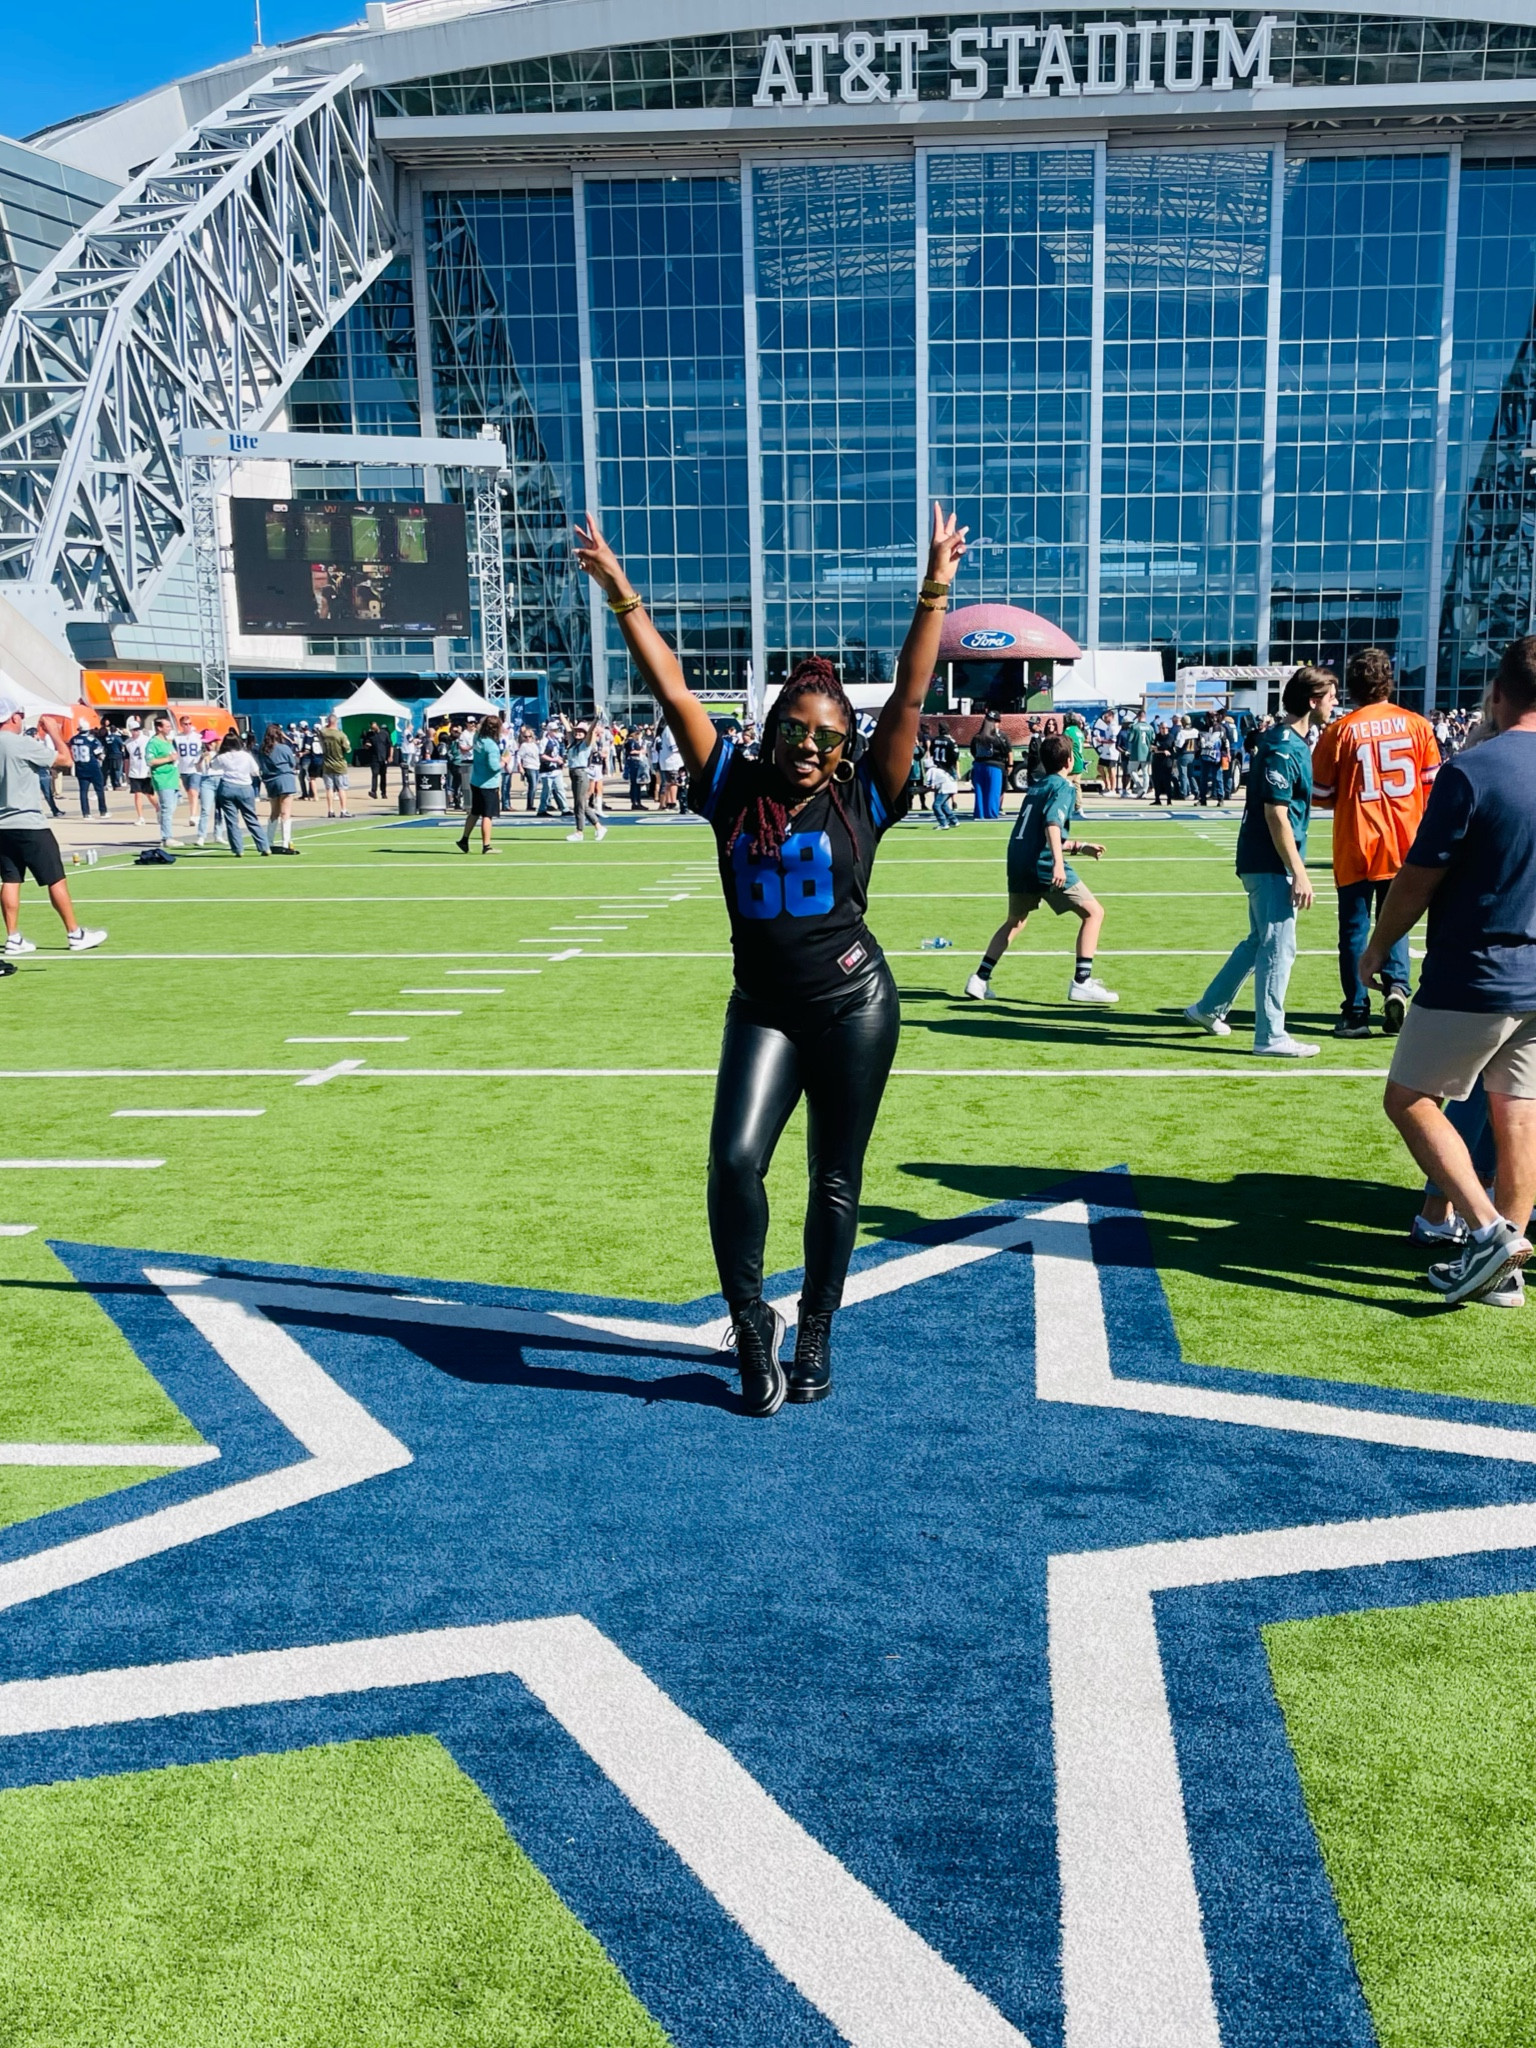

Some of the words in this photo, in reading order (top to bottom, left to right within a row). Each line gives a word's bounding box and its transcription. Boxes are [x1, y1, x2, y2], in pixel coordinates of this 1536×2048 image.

[752, 29, 929, 107] AT&T
[950, 16, 1278, 101] STADIUM
[229, 434, 258, 452] Lite
[970, 631, 1006, 647] Ford
[100, 680, 151, 697] VIZZY
[1281, 730, 1290, 741] 1
[1350, 716, 1407, 740] TEBOW
[133, 746, 142, 760] 4
[179, 743, 198, 757] 88
[934, 747, 947, 763] 11
[1356, 737, 1416, 802] 15
[1015, 803, 1033, 840] 1
